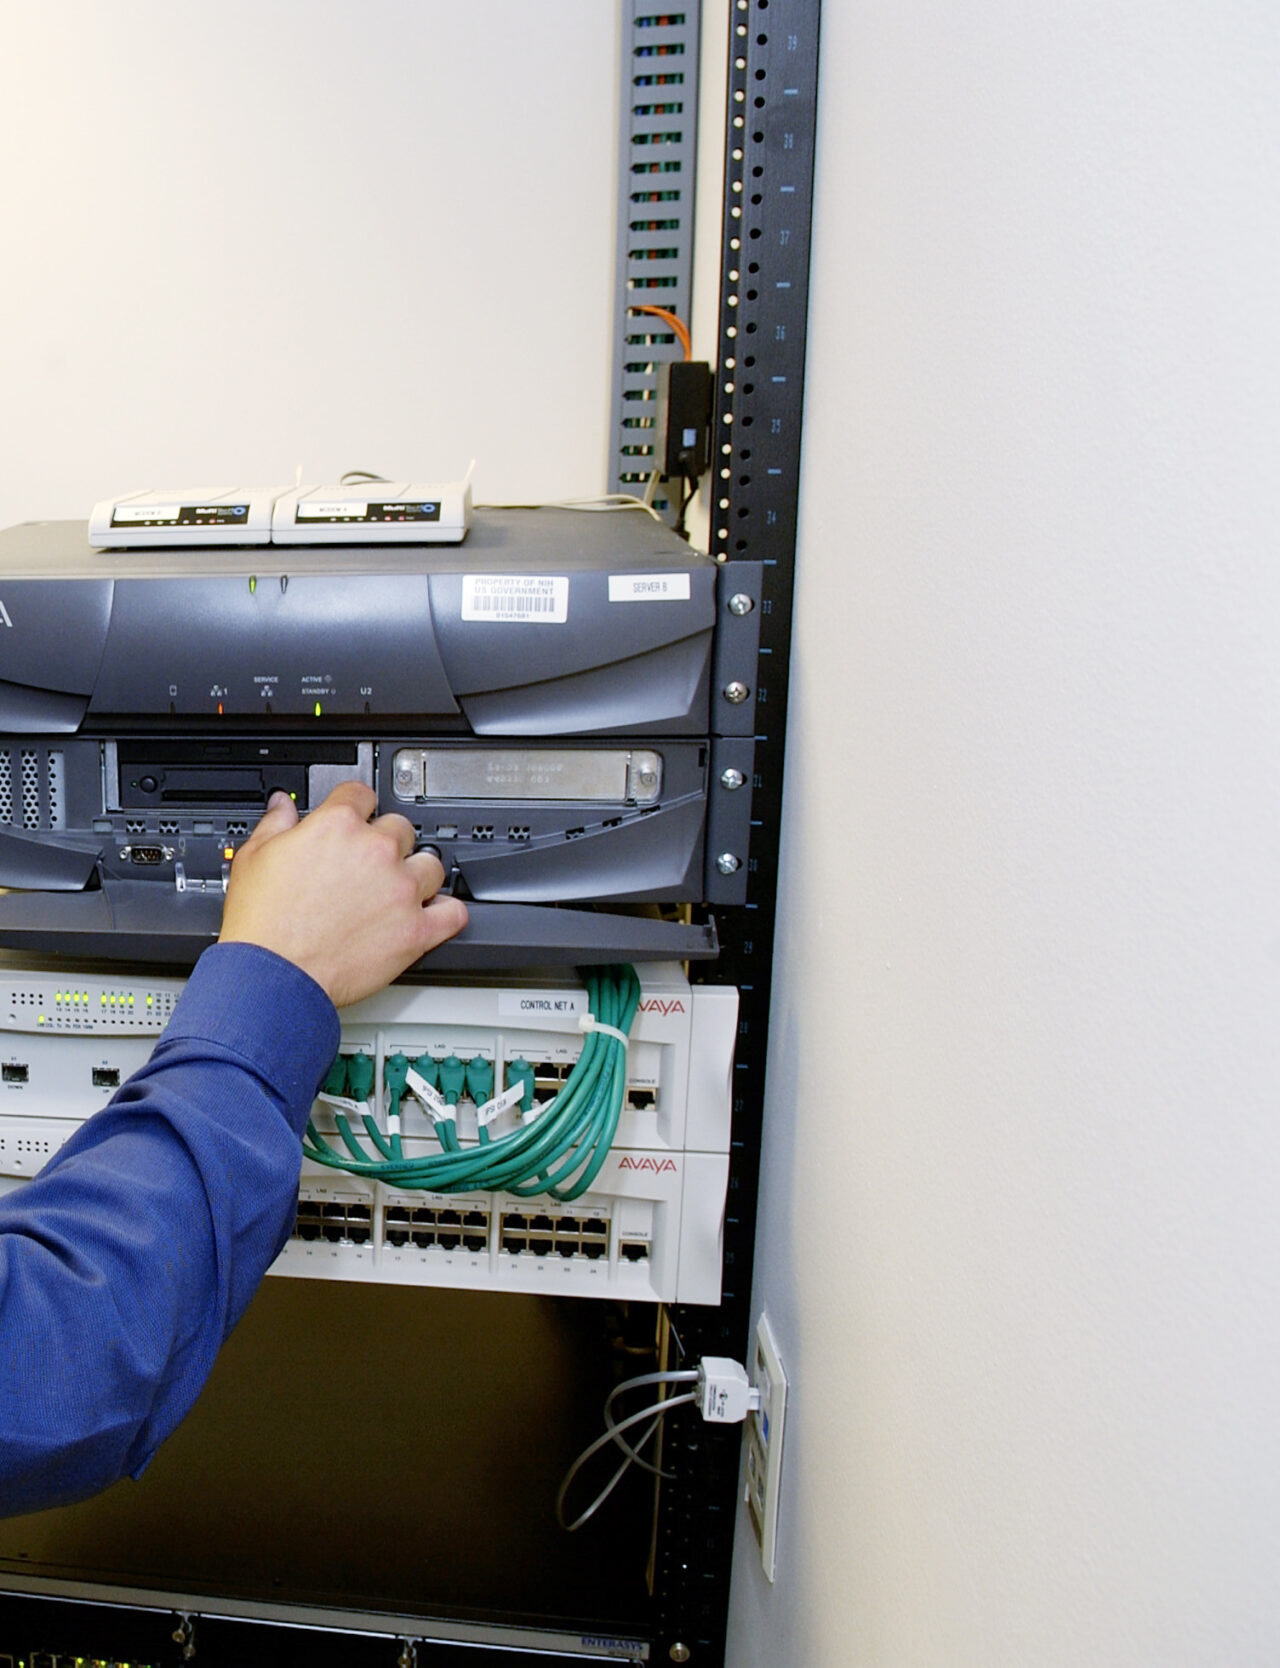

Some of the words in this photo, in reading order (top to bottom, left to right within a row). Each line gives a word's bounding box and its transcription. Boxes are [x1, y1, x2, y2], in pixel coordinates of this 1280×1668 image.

[475, 578, 521, 586] PROPERTY
[474, 586, 487, 594] US
[490, 587, 554, 595] GOVERNMENT
[633, 582, 661, 593] SERVER
[662, 582, 668, 592] B
[301, 687, 329, 695] STANDBY
[360, 687, 373, 695] U2
[520, 1000, 552, 1010] CONTROL
[554, 1000, 567, 1010] NET
[570, 1001, 575, 1011] A
[618, 1156, 678, 1175] AVAYA
[581, 1636, 643, 1650] ENTERASYS
